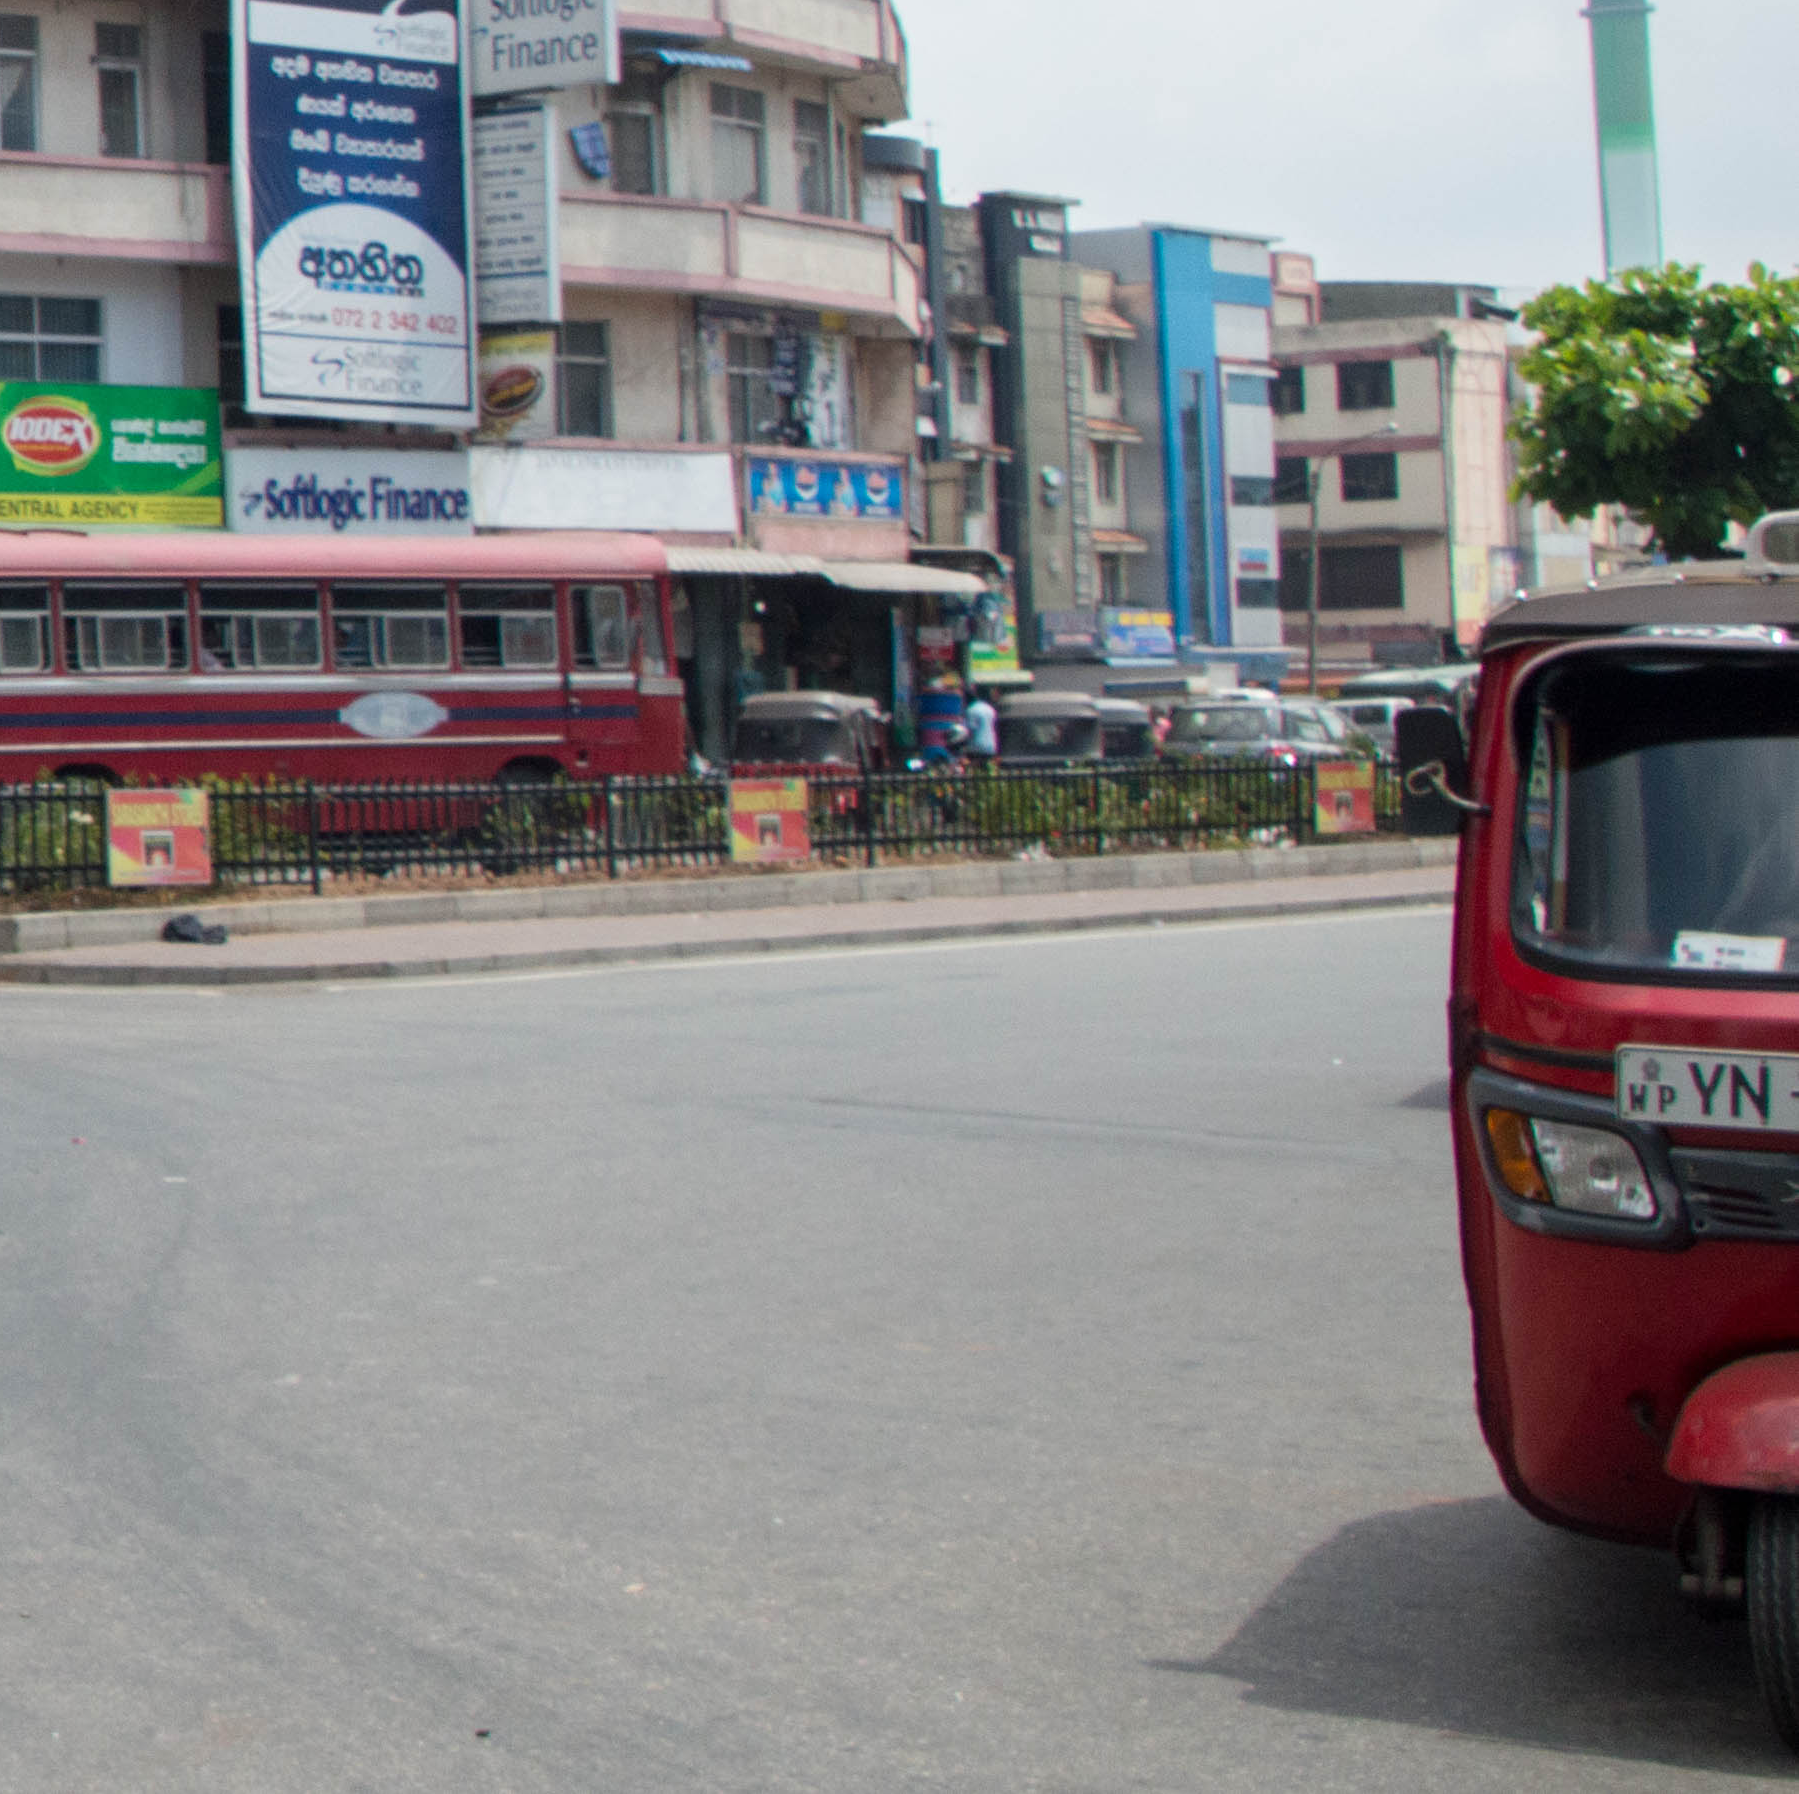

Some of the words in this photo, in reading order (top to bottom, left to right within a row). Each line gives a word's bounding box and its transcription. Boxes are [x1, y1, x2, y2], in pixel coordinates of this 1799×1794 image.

[491, 32, 599, 72] Finance
[331, 307, 364, 328] 072
[371, 311, 382, 330] 2
[388, 311, 419, 332] 342
[426, 315, 458, 335] 402
[344, 347, 421, 375] Softlogic
[345, 369, 422, 394] Finance
[9, 417, 93, 457] IODEX
[70, 501, 138, 519] AGENCY
[265, 473, 367, 531] Softlogic
[369, 477, 469, 521] Finance
[1628, 1082, 1677, 1114] WP
